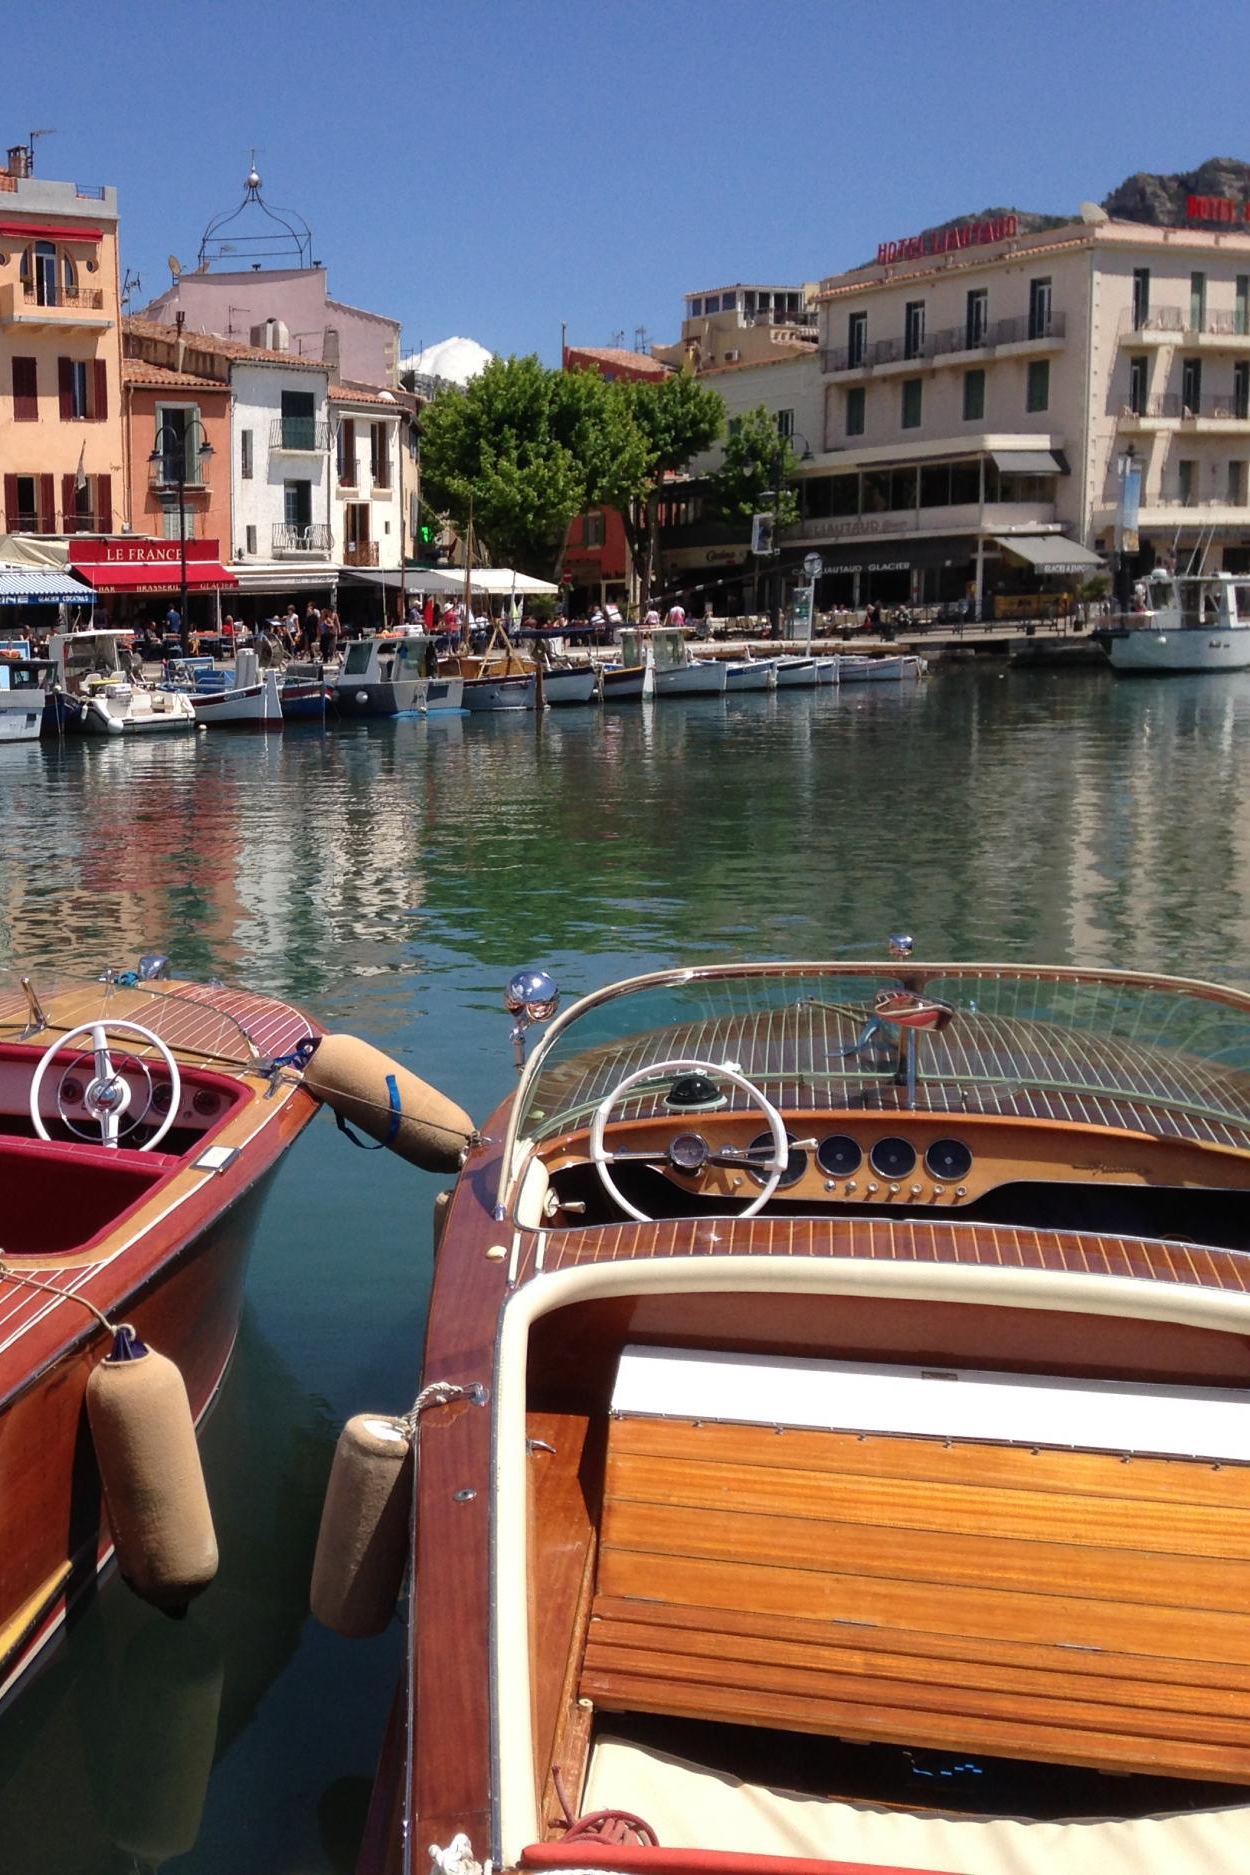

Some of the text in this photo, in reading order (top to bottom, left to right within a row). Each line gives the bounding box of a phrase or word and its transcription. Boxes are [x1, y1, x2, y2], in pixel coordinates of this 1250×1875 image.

[1186, 195, 1234, 222] HOTEL
[878, 214, 1017, 265] HOTEL LIAUTAUD
[107, 548, 183, 561] LE FRANCE
[868, 561, 911, 572] GLACIER
[200, 582, 234, 590] GLACIER
